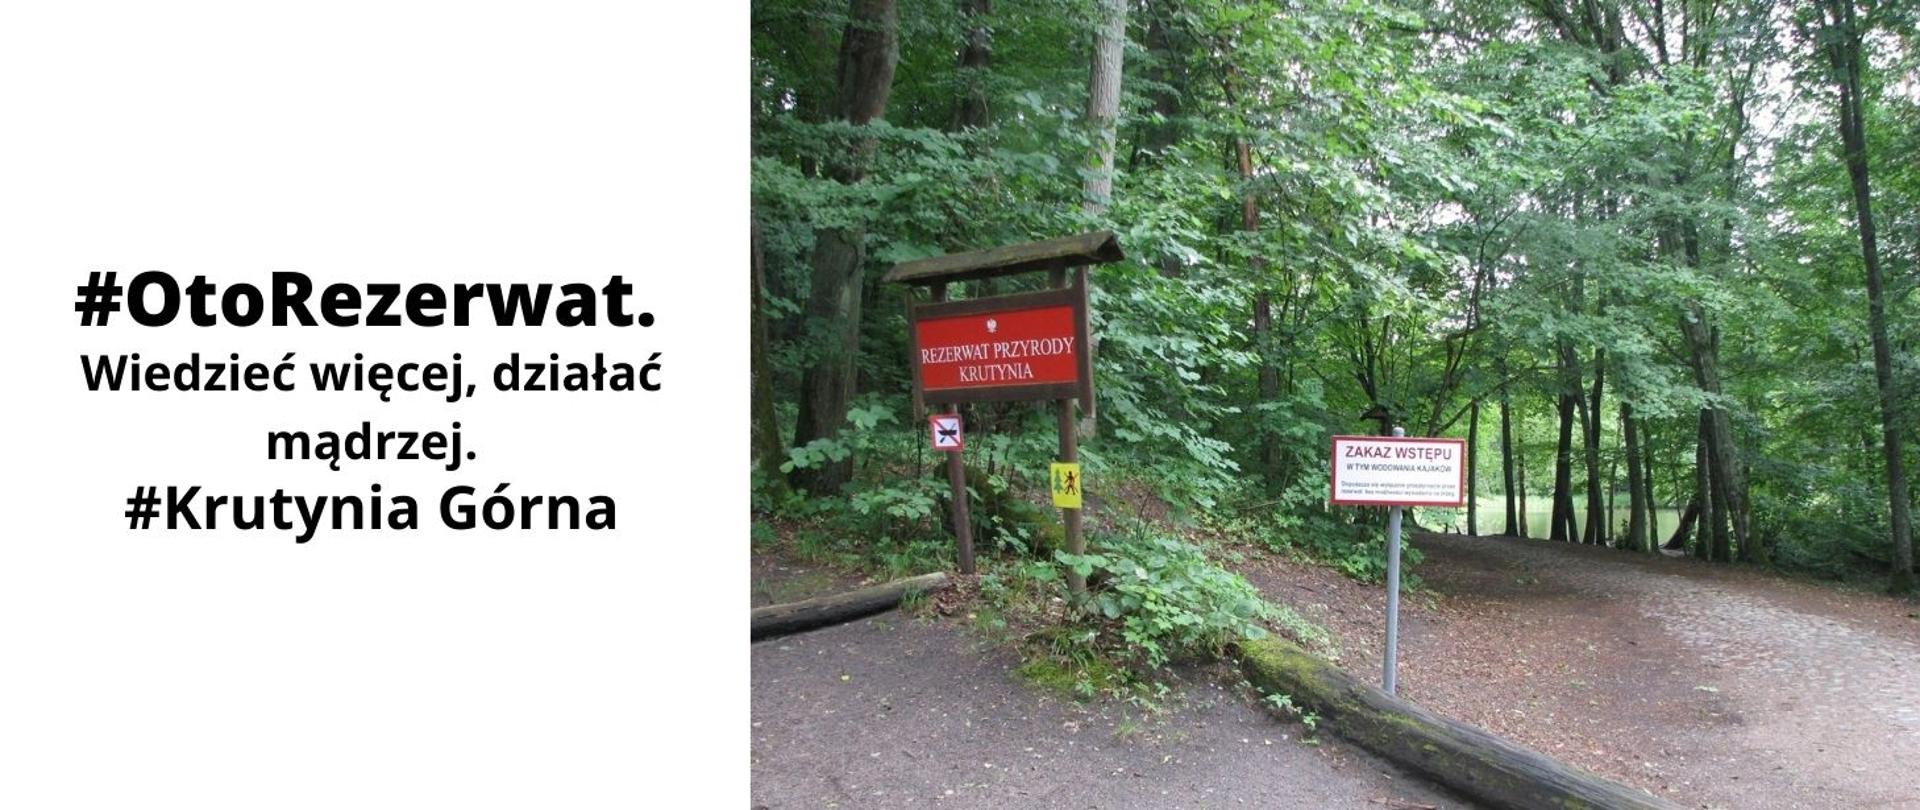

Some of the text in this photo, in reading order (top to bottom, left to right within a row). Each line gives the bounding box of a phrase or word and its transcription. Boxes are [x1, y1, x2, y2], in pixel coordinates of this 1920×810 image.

[921, 337, 1075, 364] REZERWAT PRZYRODY
[959, 362, 1034, 382] KRUTYNIA
[1345, 445, 1452, 463] ZAKAZ WSTĘPU
[1371, 463, 1415, 472] WODOWANIA
